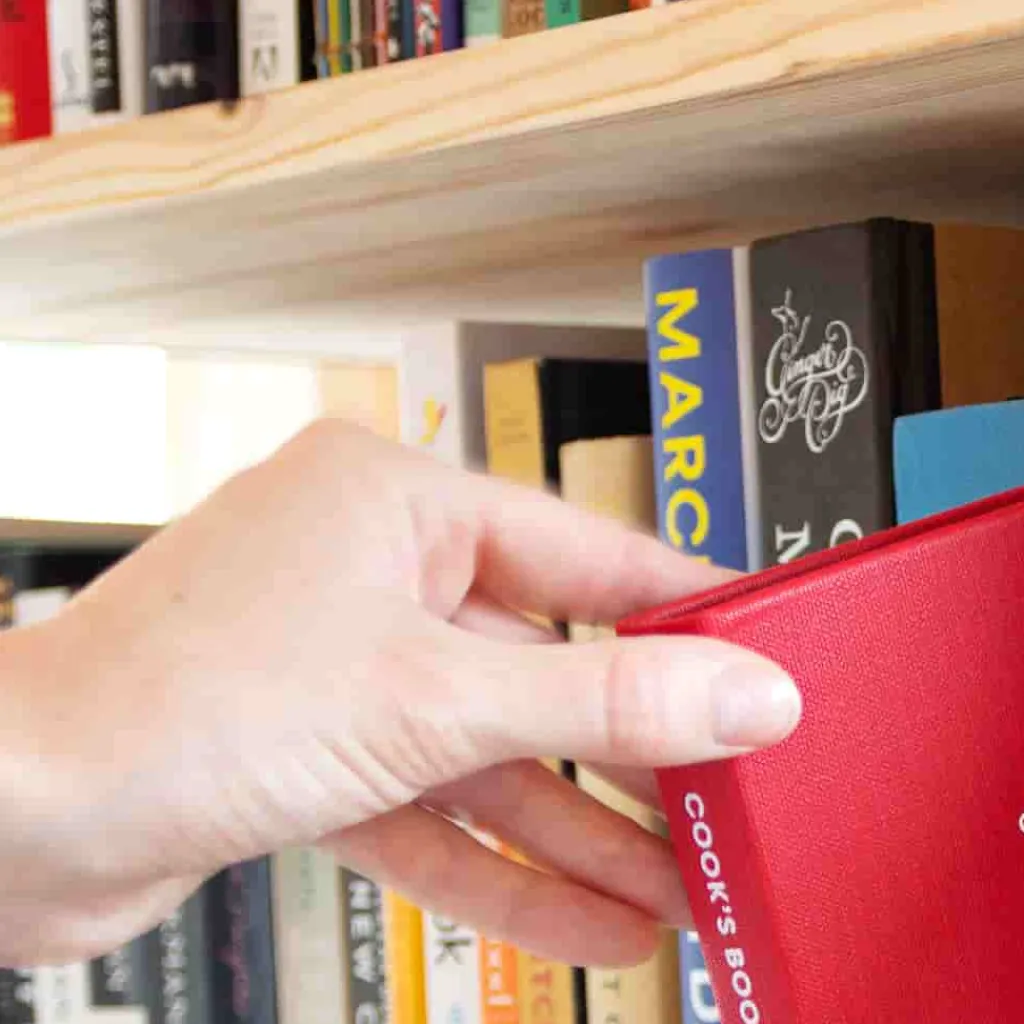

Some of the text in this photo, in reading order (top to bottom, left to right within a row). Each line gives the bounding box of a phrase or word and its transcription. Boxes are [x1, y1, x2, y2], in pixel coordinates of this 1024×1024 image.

[654, 286, 710, 567] MARC
[348, 878, 376, 985] NEW
[684, 791, 737, 936] COOK'S
